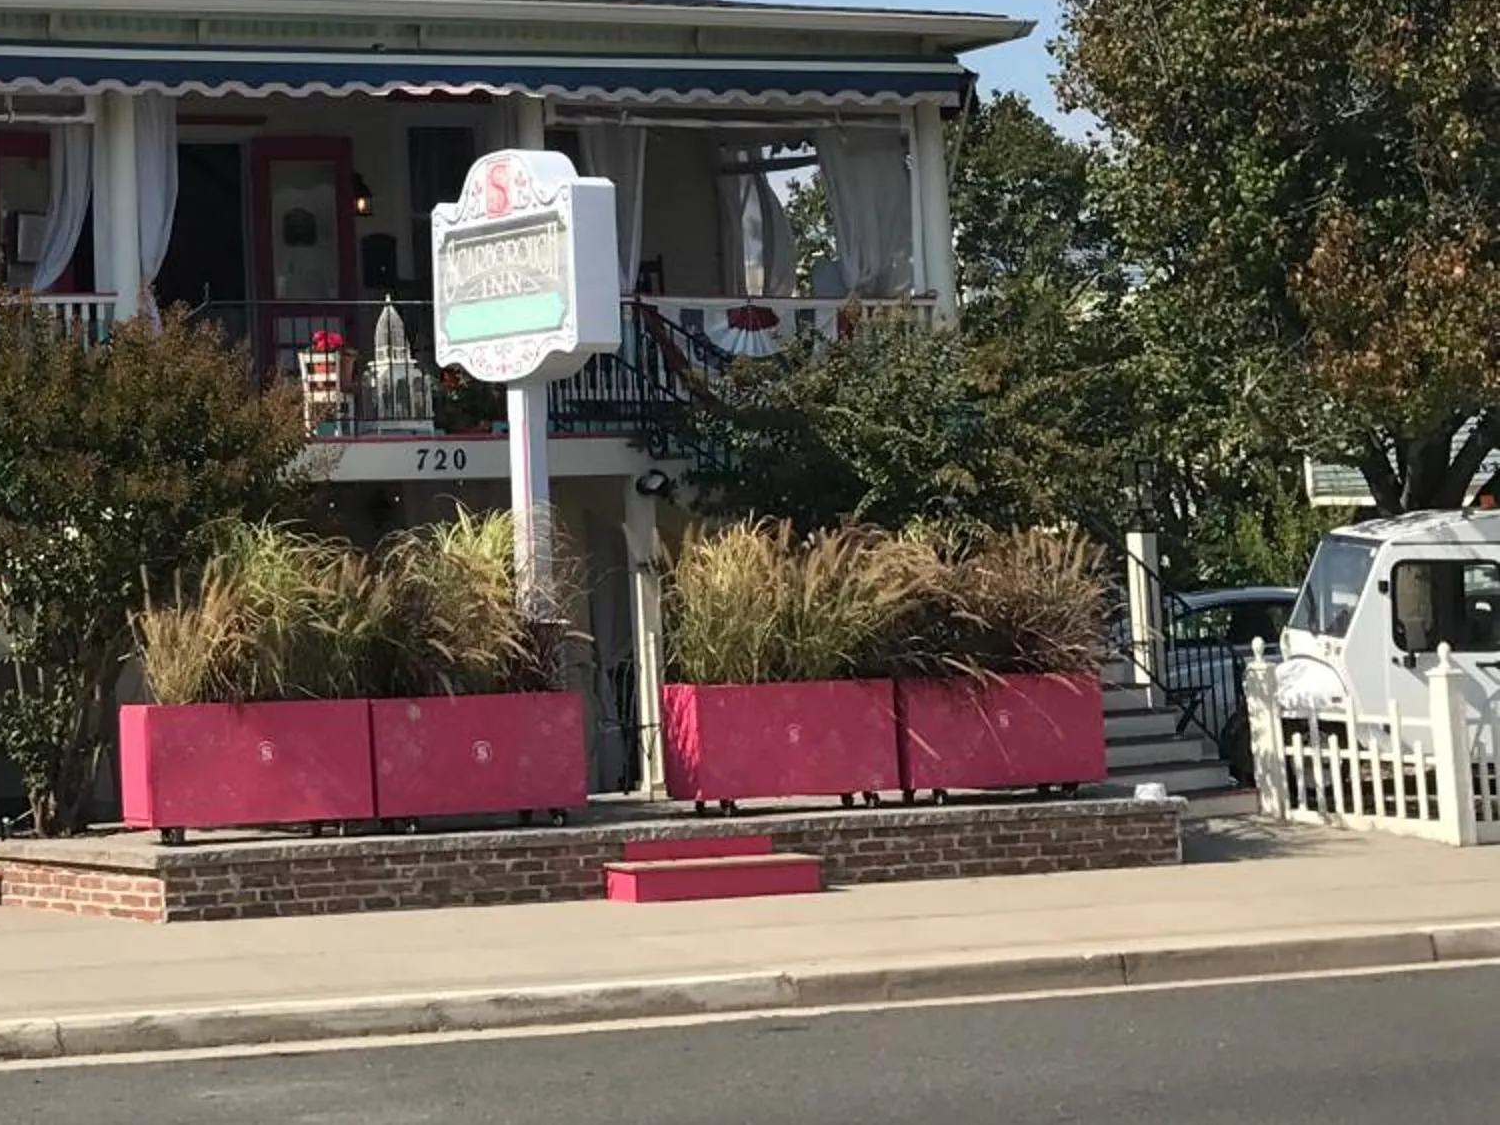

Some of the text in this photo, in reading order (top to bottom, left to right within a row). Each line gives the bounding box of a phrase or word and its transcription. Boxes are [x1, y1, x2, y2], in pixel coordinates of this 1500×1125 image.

[489, 162, 510, 216] S
[482, 271, 521, 297] INN
[417, 448, 467, 471] 720
